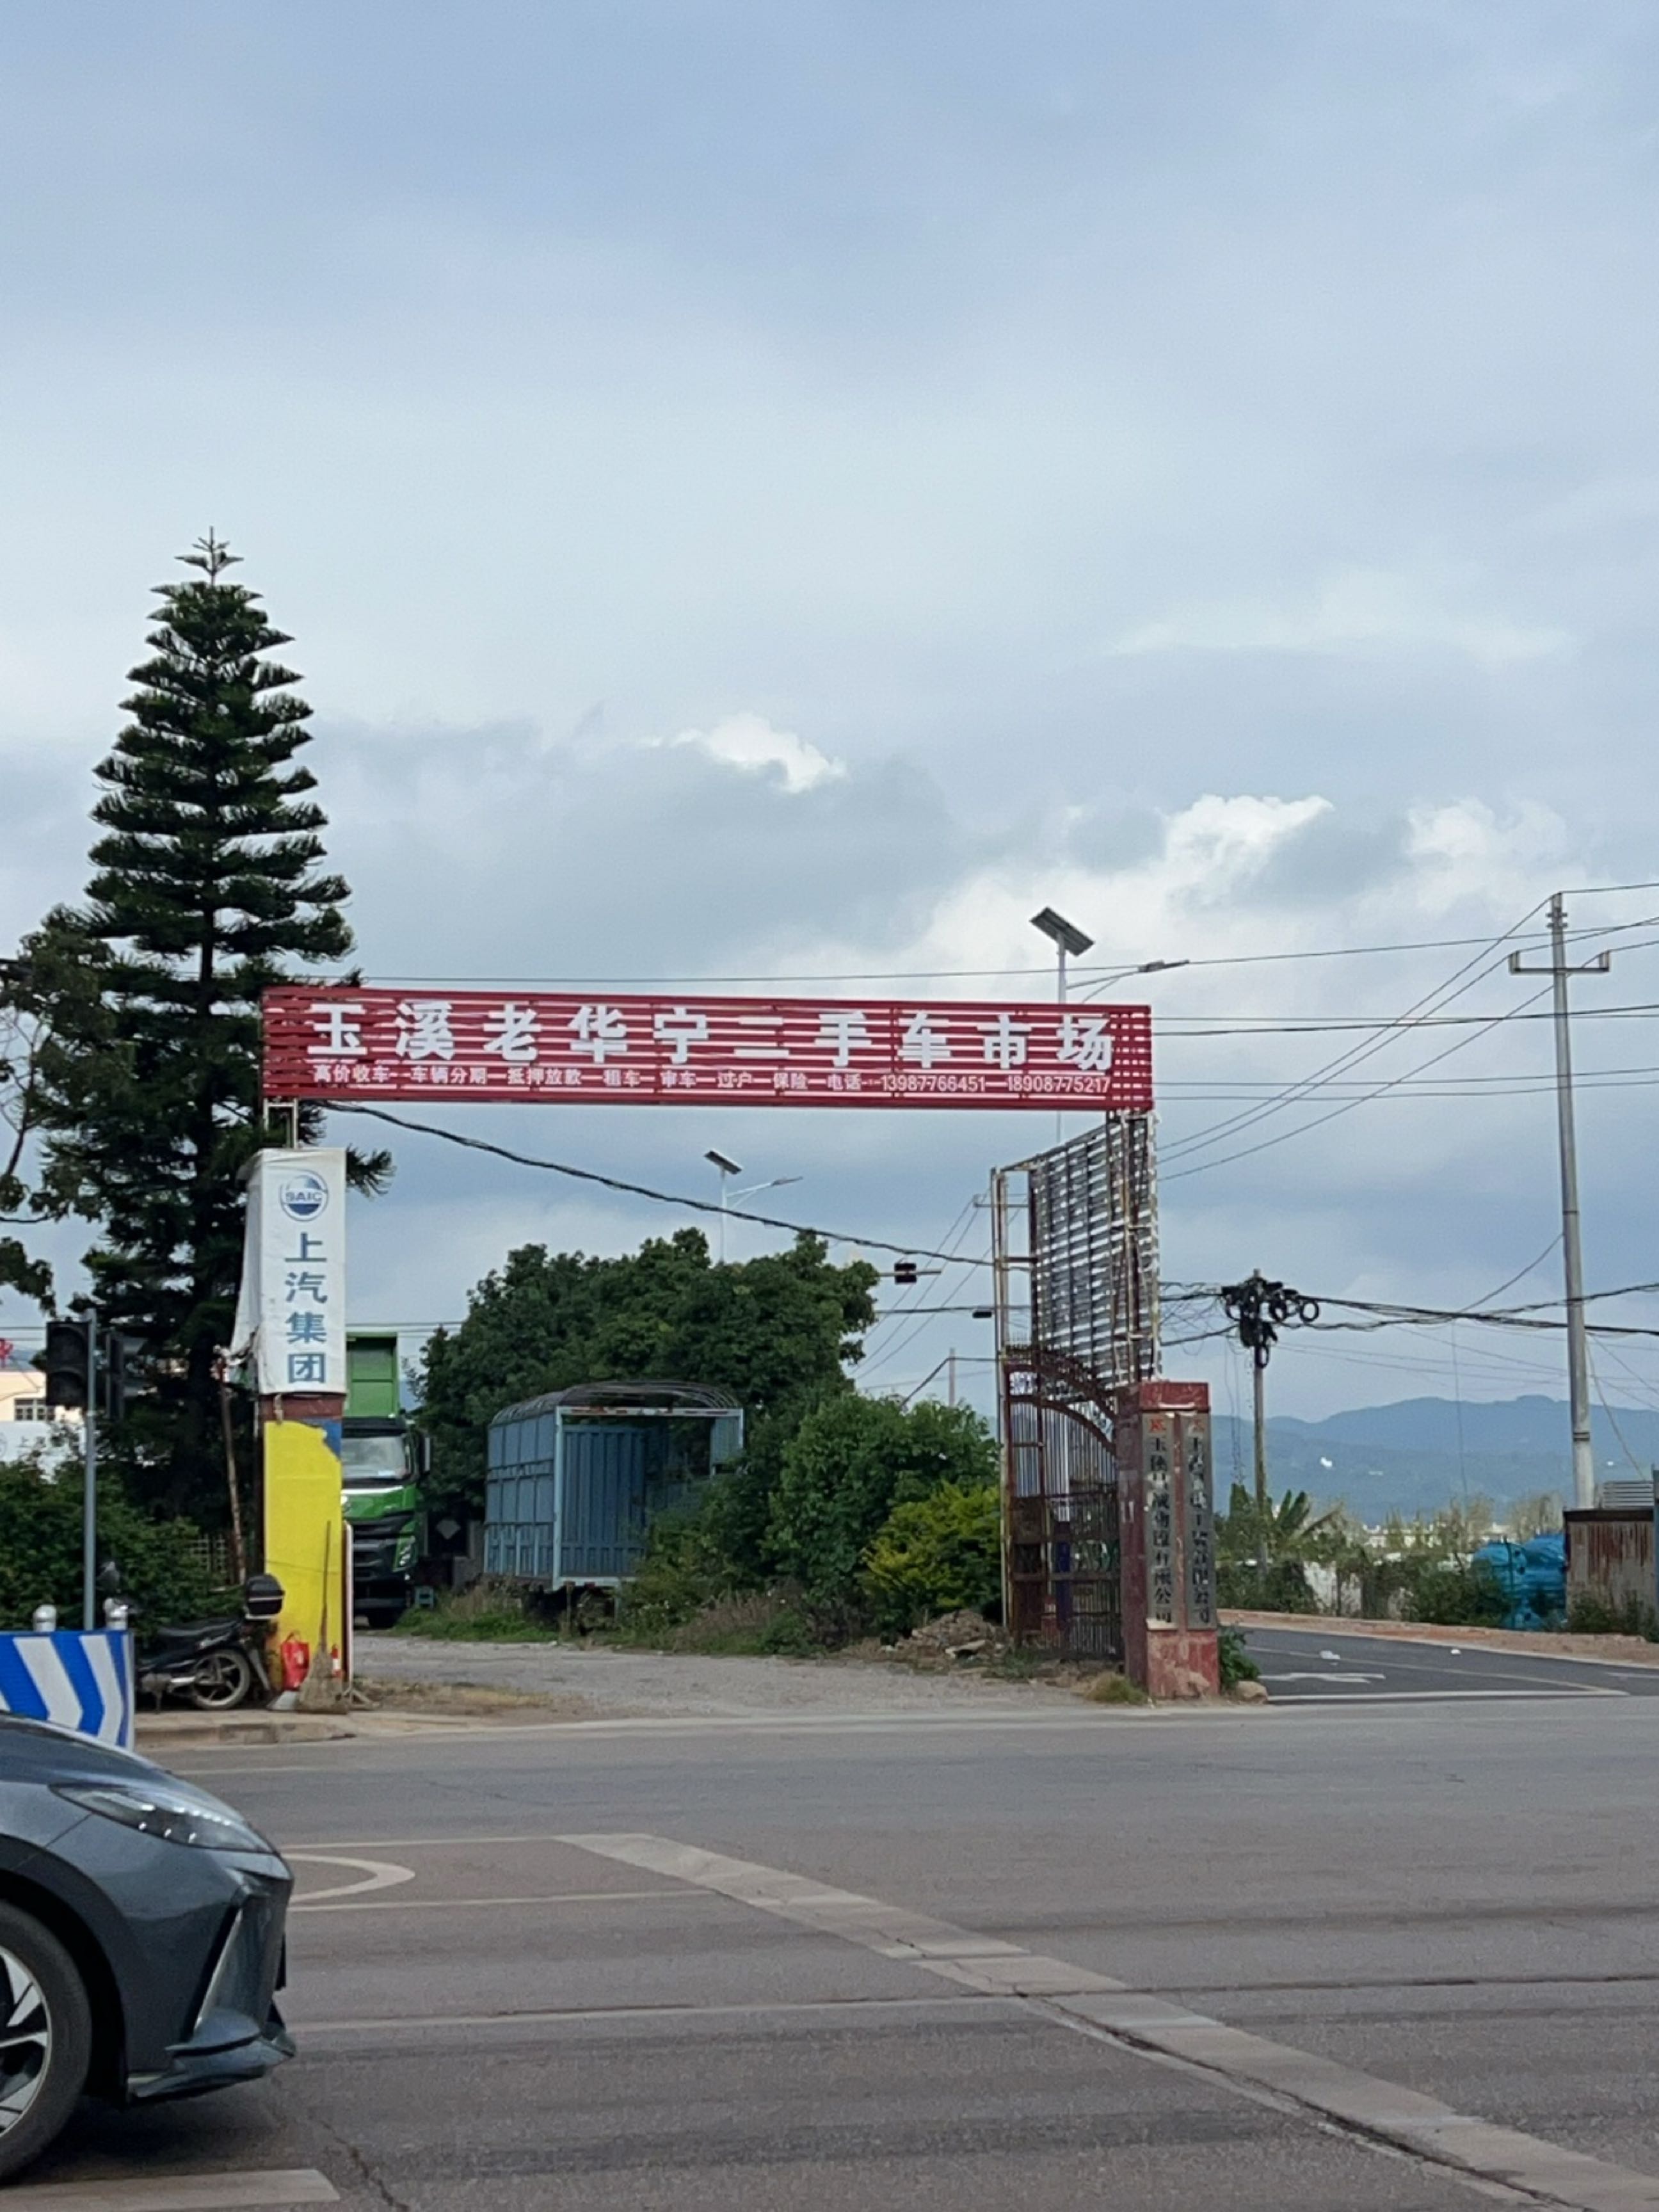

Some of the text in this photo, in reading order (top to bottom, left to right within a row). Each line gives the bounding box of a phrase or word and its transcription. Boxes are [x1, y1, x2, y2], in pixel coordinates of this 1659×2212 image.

[307, 1002, 1112, 1071] 玉溪老华宁二手车市场
[313, 1063, 390, 1084] 高价收车
[410, 1065, 488, 1085] 车辆分期
[603, 1069, 641, 1087] 租车
[660, 1070, 697, 1088] 审车
[717, 1070, 753, 1089] 过户
[773, 1072, 808, 1090] 保险
[881, 1074, 986, 1092] 13987766451
[1007, 1075, 1111, 1094] 18908775217
[285, 1191, 323, 1202] SAIC
[285, 1231, 328, 1384] 上汽集团
